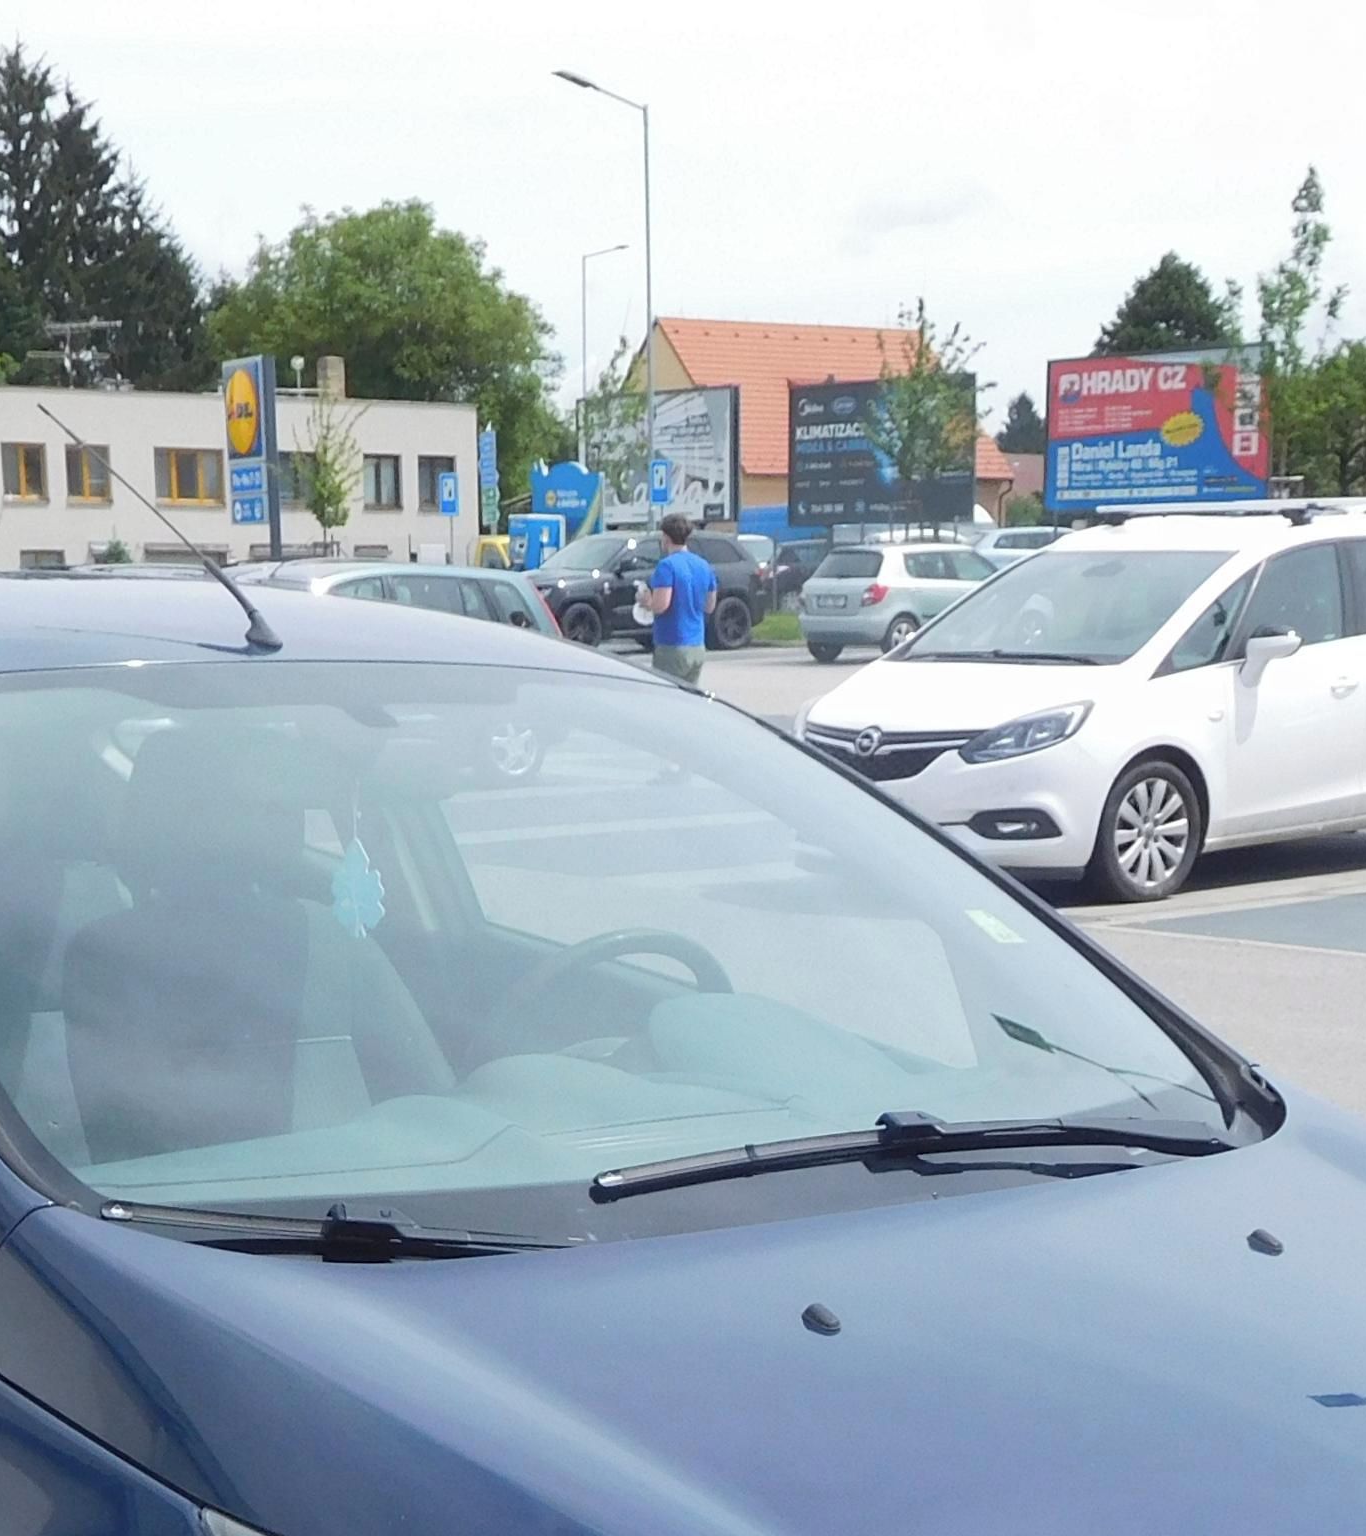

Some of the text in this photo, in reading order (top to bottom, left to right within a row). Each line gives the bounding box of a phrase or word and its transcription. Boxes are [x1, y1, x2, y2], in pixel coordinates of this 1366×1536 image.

[1081, 365, 1187, 395] HRADY CZ
[1071, 438, 1162, 460] Daniel Landa
